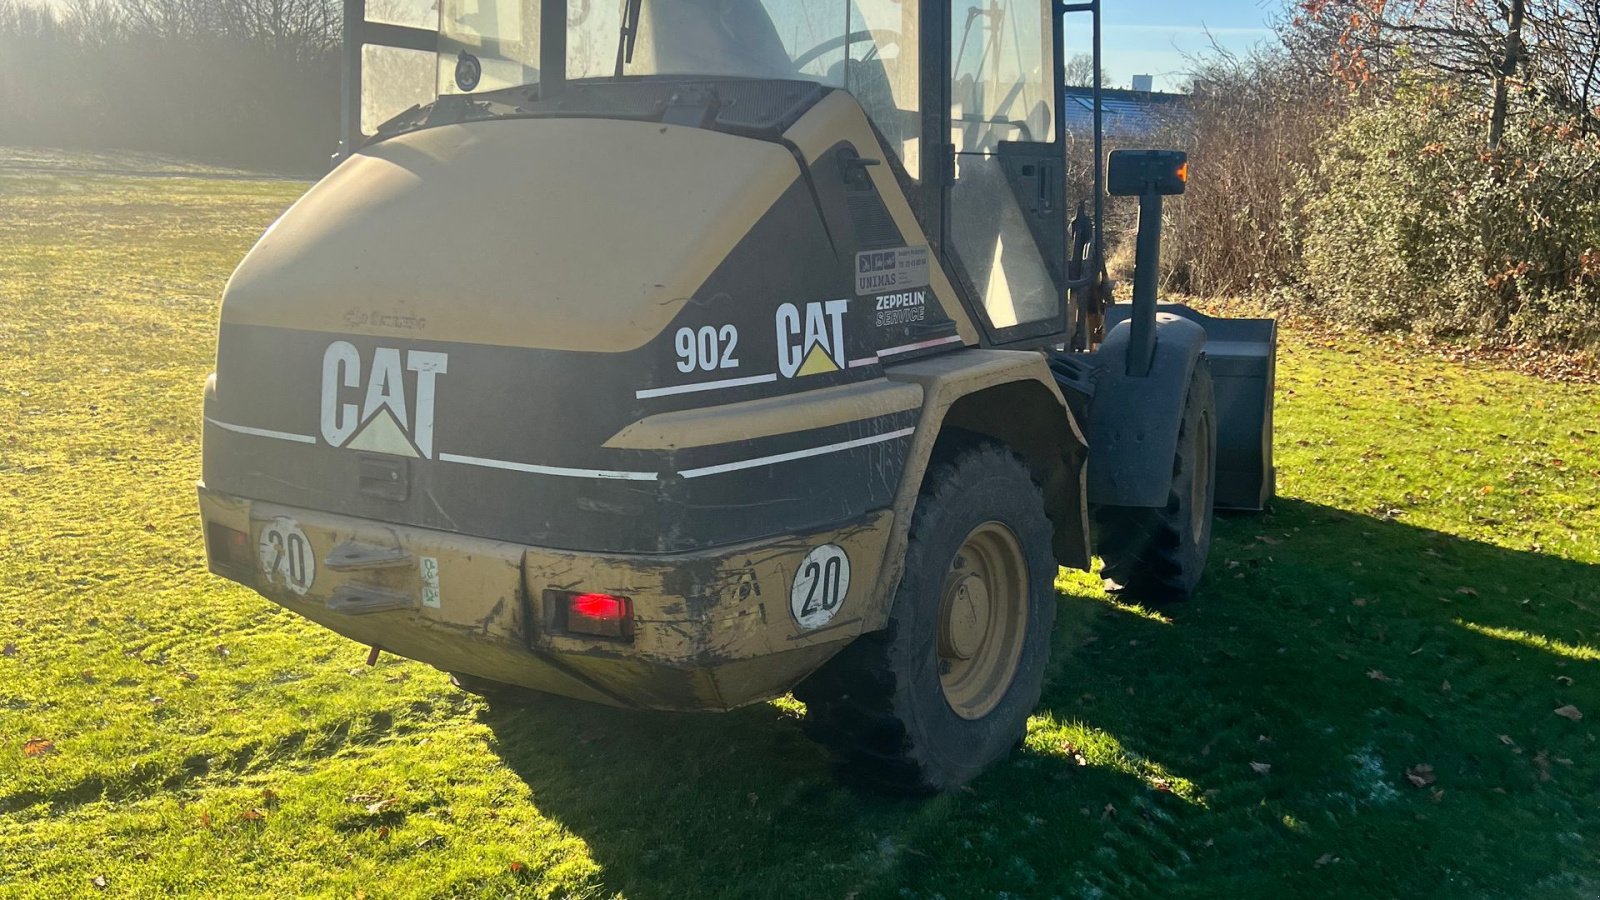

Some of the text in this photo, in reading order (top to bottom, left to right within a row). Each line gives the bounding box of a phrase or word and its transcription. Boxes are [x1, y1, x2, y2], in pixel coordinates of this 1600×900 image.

[859, 273, 896, 290] UNIMAS
[876, 291, 925, 310] ZEPPELIN
[775, 300, 847, 379] CAT
[875, 306, 924, 327] SERVICE
[675, 324, 739, 373] 902
[320, 340, 448, 459] CAT
[268, 529, 305, 588] 20
[801, 556, 841, 618] 20
